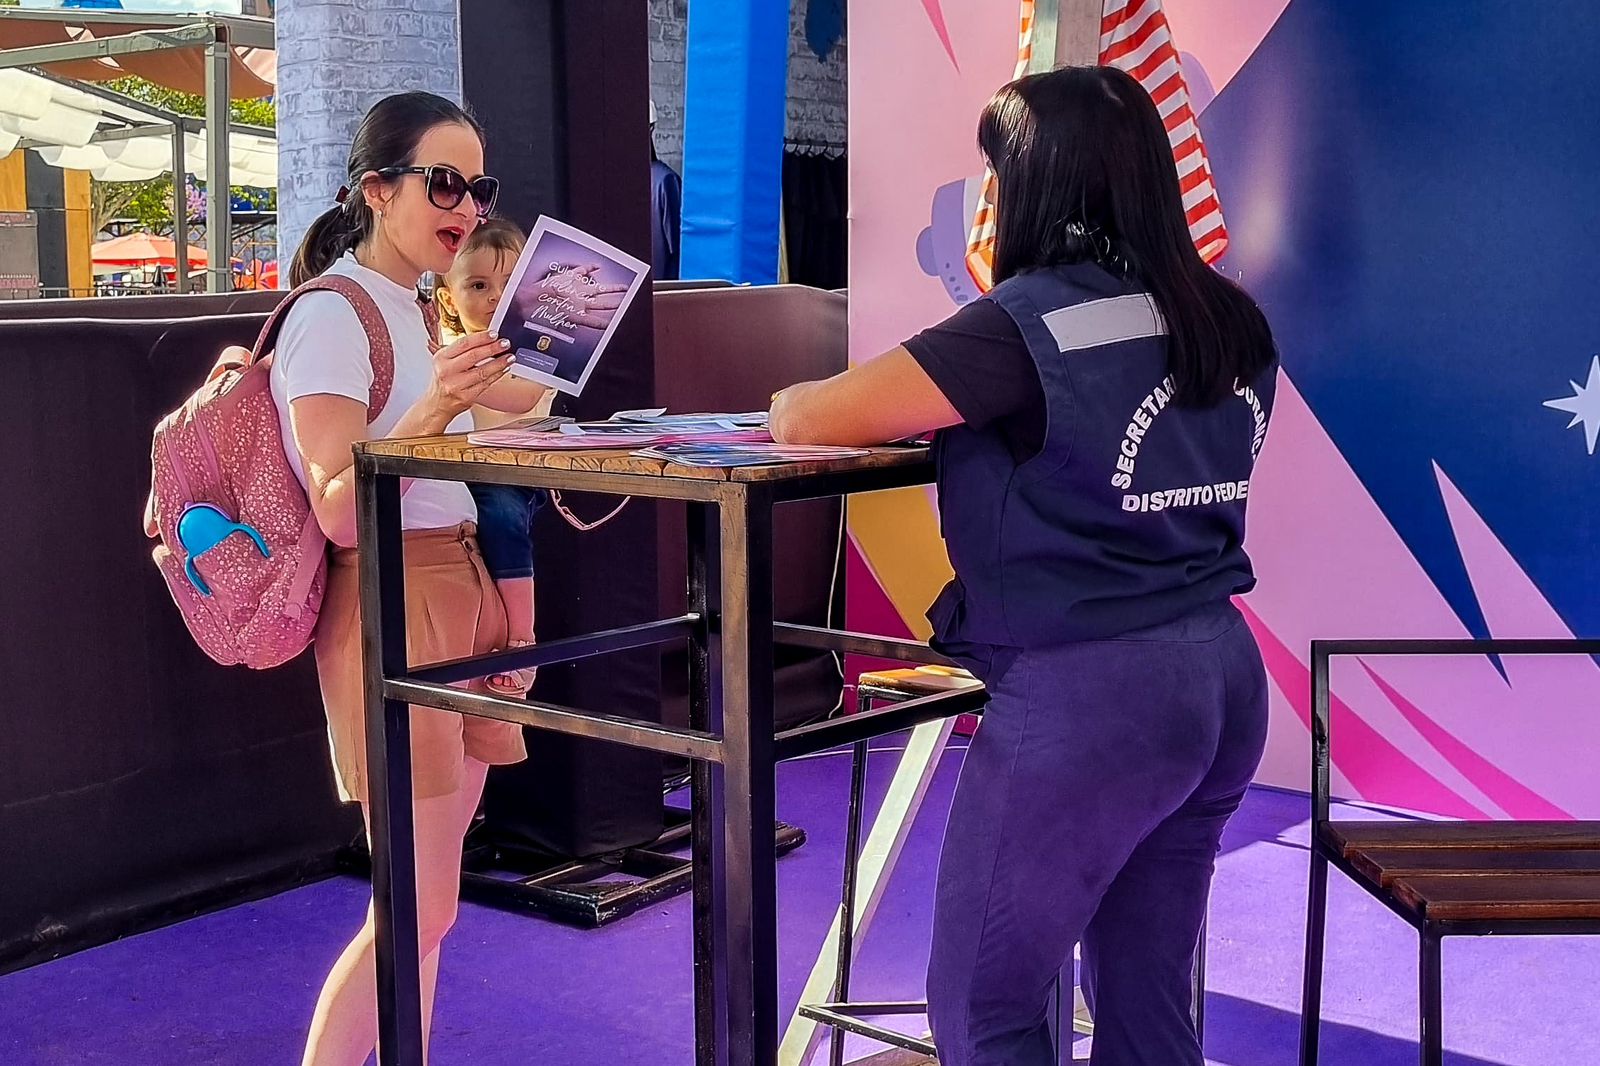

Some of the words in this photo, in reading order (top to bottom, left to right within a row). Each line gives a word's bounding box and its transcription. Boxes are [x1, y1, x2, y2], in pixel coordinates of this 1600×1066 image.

[575, 274, 607, 292] sobre
[538, 293, 575, 312] contra
[531, 305, 578, 329] Mulher
[1121, 484, 1213, 513] DISTRITO
[1213, 480, 1249, 503] FEDE
